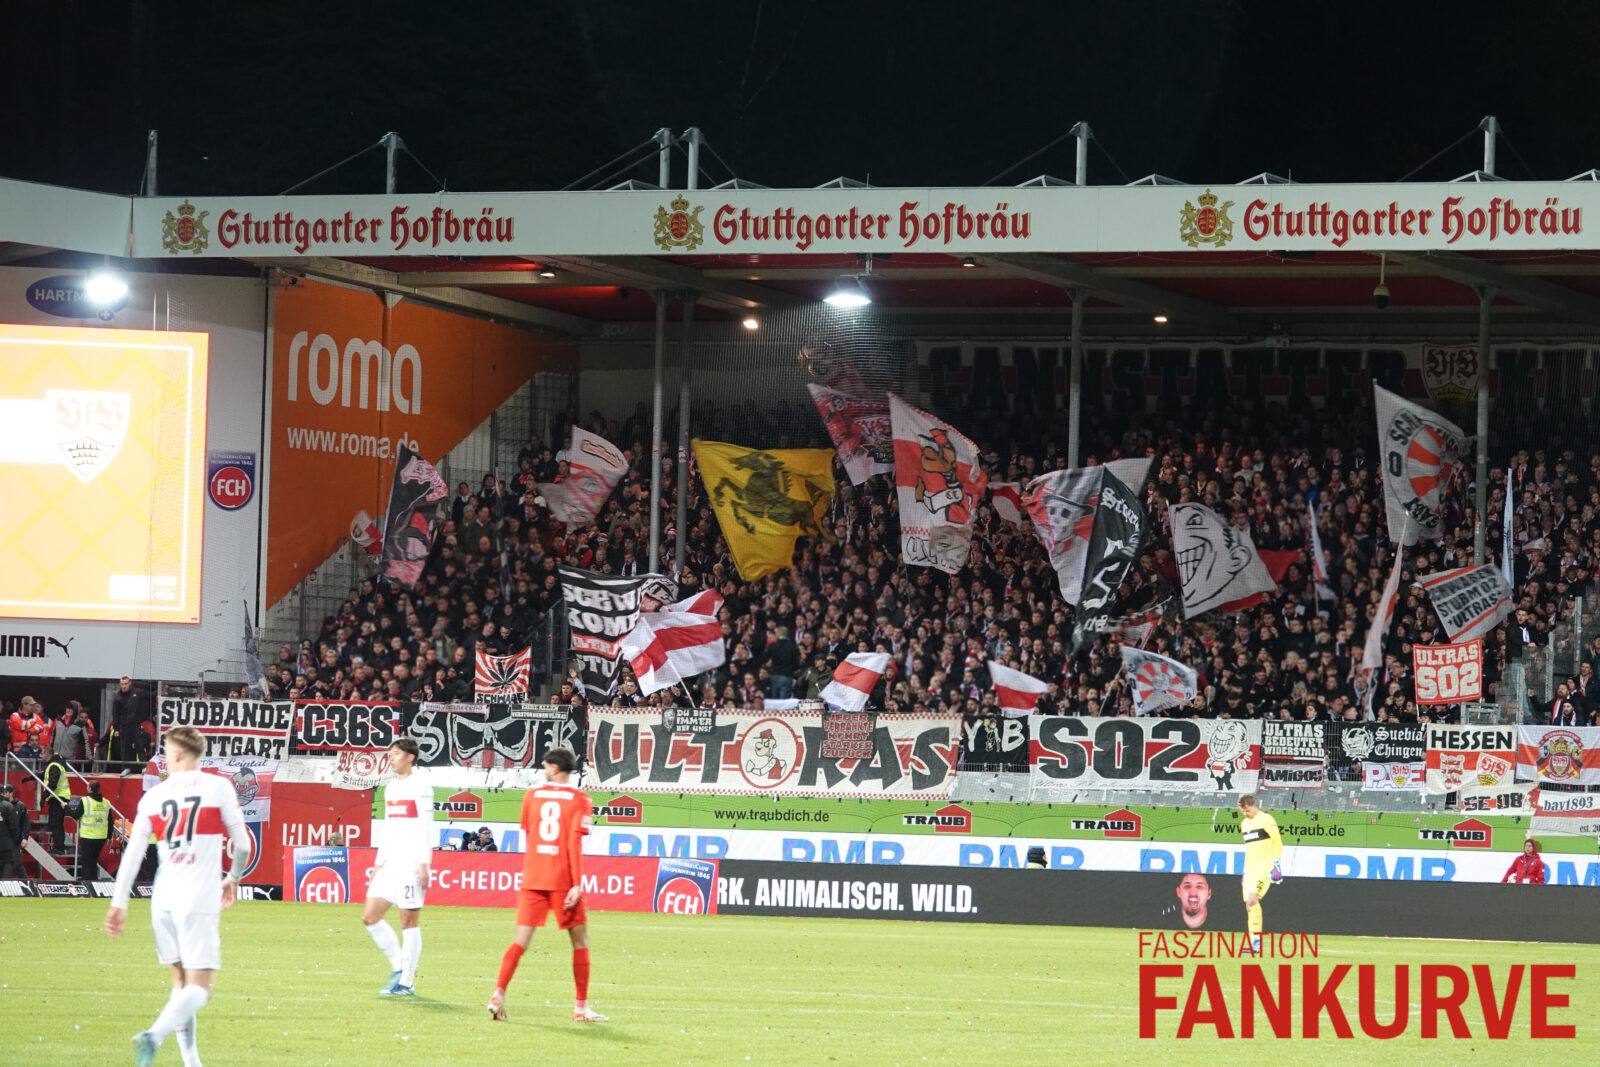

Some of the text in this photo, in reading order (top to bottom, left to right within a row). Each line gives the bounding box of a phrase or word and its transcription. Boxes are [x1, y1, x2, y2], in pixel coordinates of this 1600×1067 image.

[713, 201, 1032, 252] Stuttgarter Hofbräu
[1243, 196, 1583, 248] Stuttgarter Hofbräu
[218, 206, 515, 255] Stuttgarter Hofbräu
[287, 330, 422, 415] roma
[217, 479, 246, 497] FCH
[1416, 644, 1479, 666] ULTRAS
[161, 698, 291, 730] SÜDBANDE
[676, 709, 690, 717] DU
[829, 713, 868, 721] JEDER
[303, 704, 394, 749] C36S
[676, 717, 713, 726] IMMER
[823, 720, 874, 732] VERBANNTE
[828, 732, 869, 740] KEHRT
[1264, 723, 1324, 738] ULTRAS
[1375, 726, 1423, 742] Suebia
[1264, 736, 1324, 748] BEDEUTET
[1431, 729, 1513, 751] HESSEN
[1263, 746, 1325, 757] WIDERSTAND
[1480, 757, 1507, 777] VfB
[434, 803, 477, 812] RAUB
[592, 806, 636, 816] RAUB
[715, 808, 830, 823] www.traubdich.de
[161, 796, 202, 850] 27
[539, 801, 561, 842] 8
[904, 815, 965, 826] TRAUB
[1072, 820, 1135, 831] TRAUB
[1420, 829, 1485, 841] TRAUB
[306, 882, 339, 903] FCH
[404, 885, 415, 899] 21
[754, 878, 904, 911] ANIMALISCH.
[911, 883, 978, 914] WILD.
[663, 891, 699, 914] FCH
